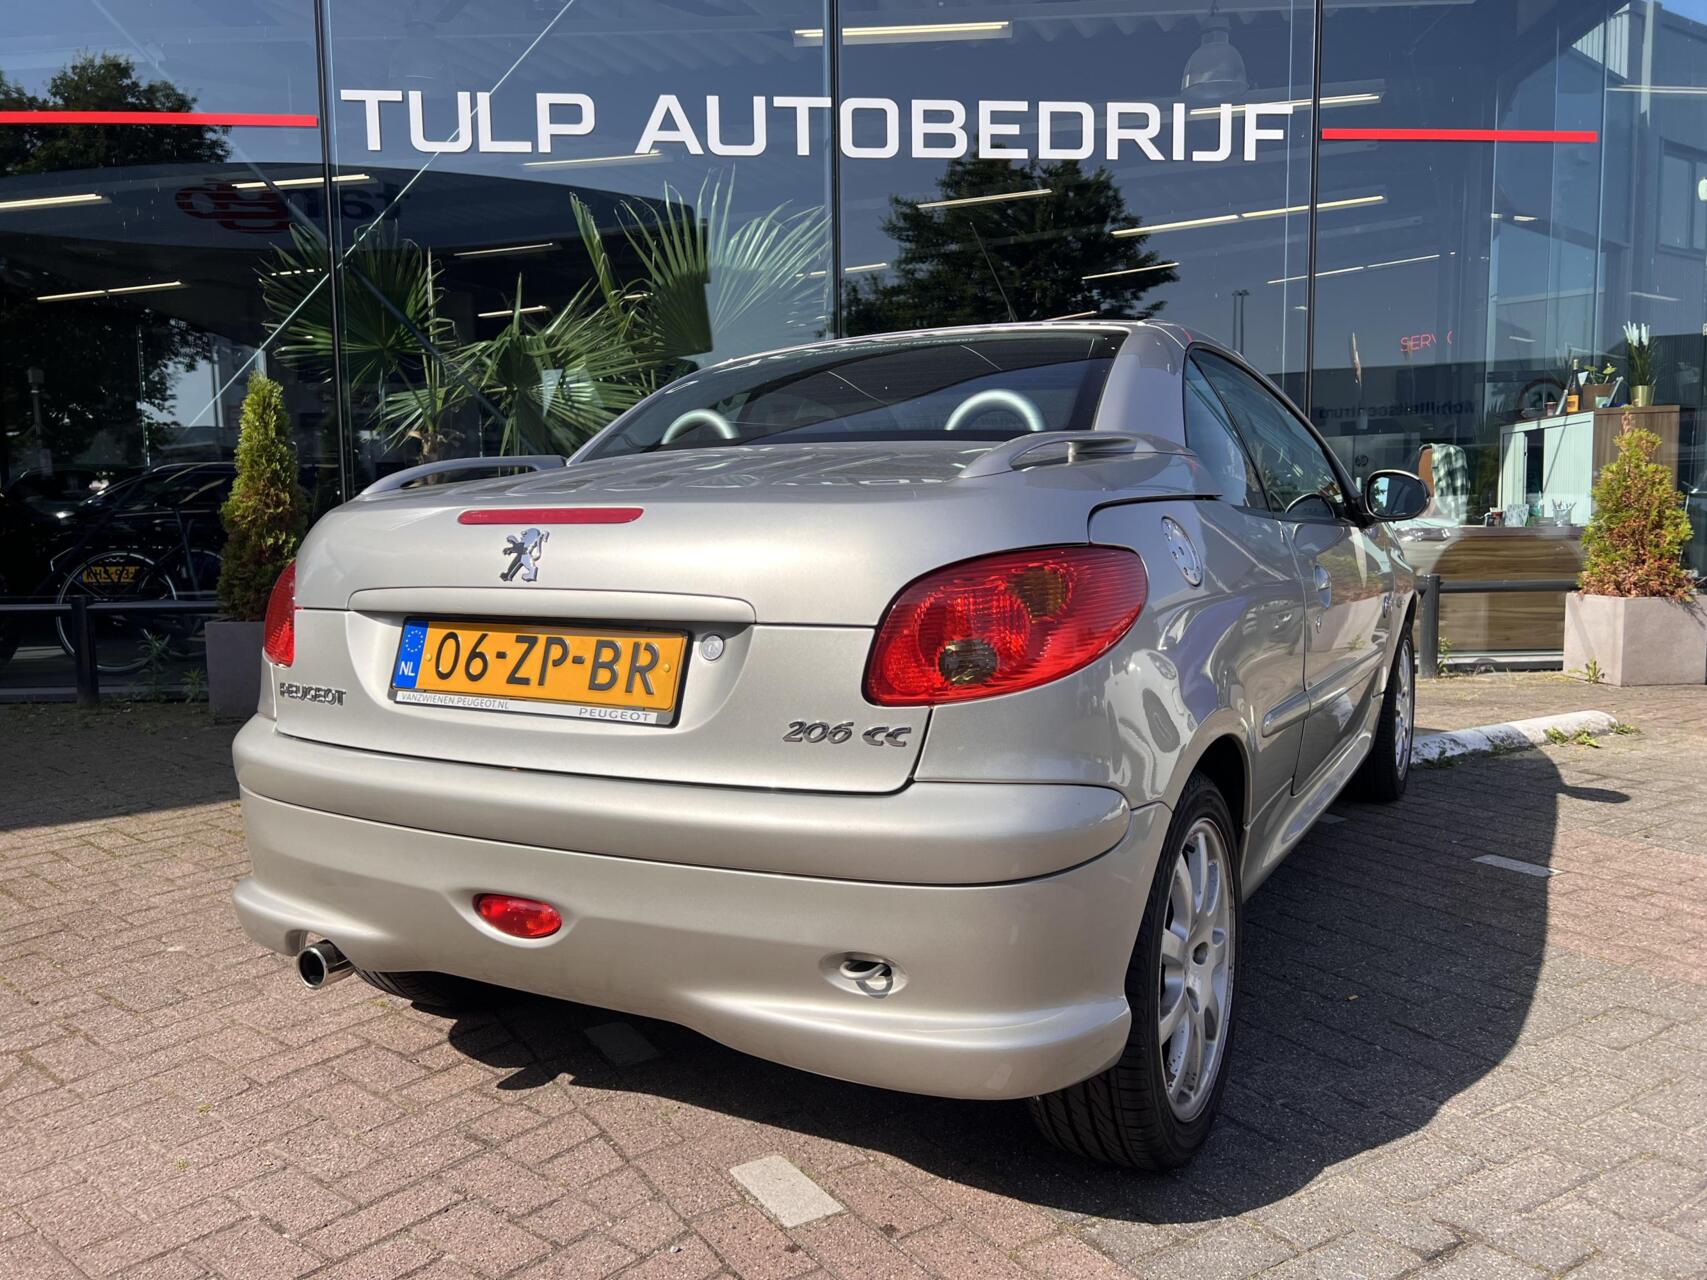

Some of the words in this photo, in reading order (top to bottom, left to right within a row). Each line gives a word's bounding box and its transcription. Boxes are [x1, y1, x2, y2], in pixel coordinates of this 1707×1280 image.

[340, 89, 596, 154] TULP
[634, 93, 1294, 162] AUTOBEDRIJF
[399, 661, 416, 677] NL
[434, 631, 660, 695] 06-ZP-BR
[279, 682, 347, 706] PEUGEOT
[578, 707, 651, 722] PEUGEOT
[782, 720, 854, 744] 206
[862, 726, 912, 747] CC
